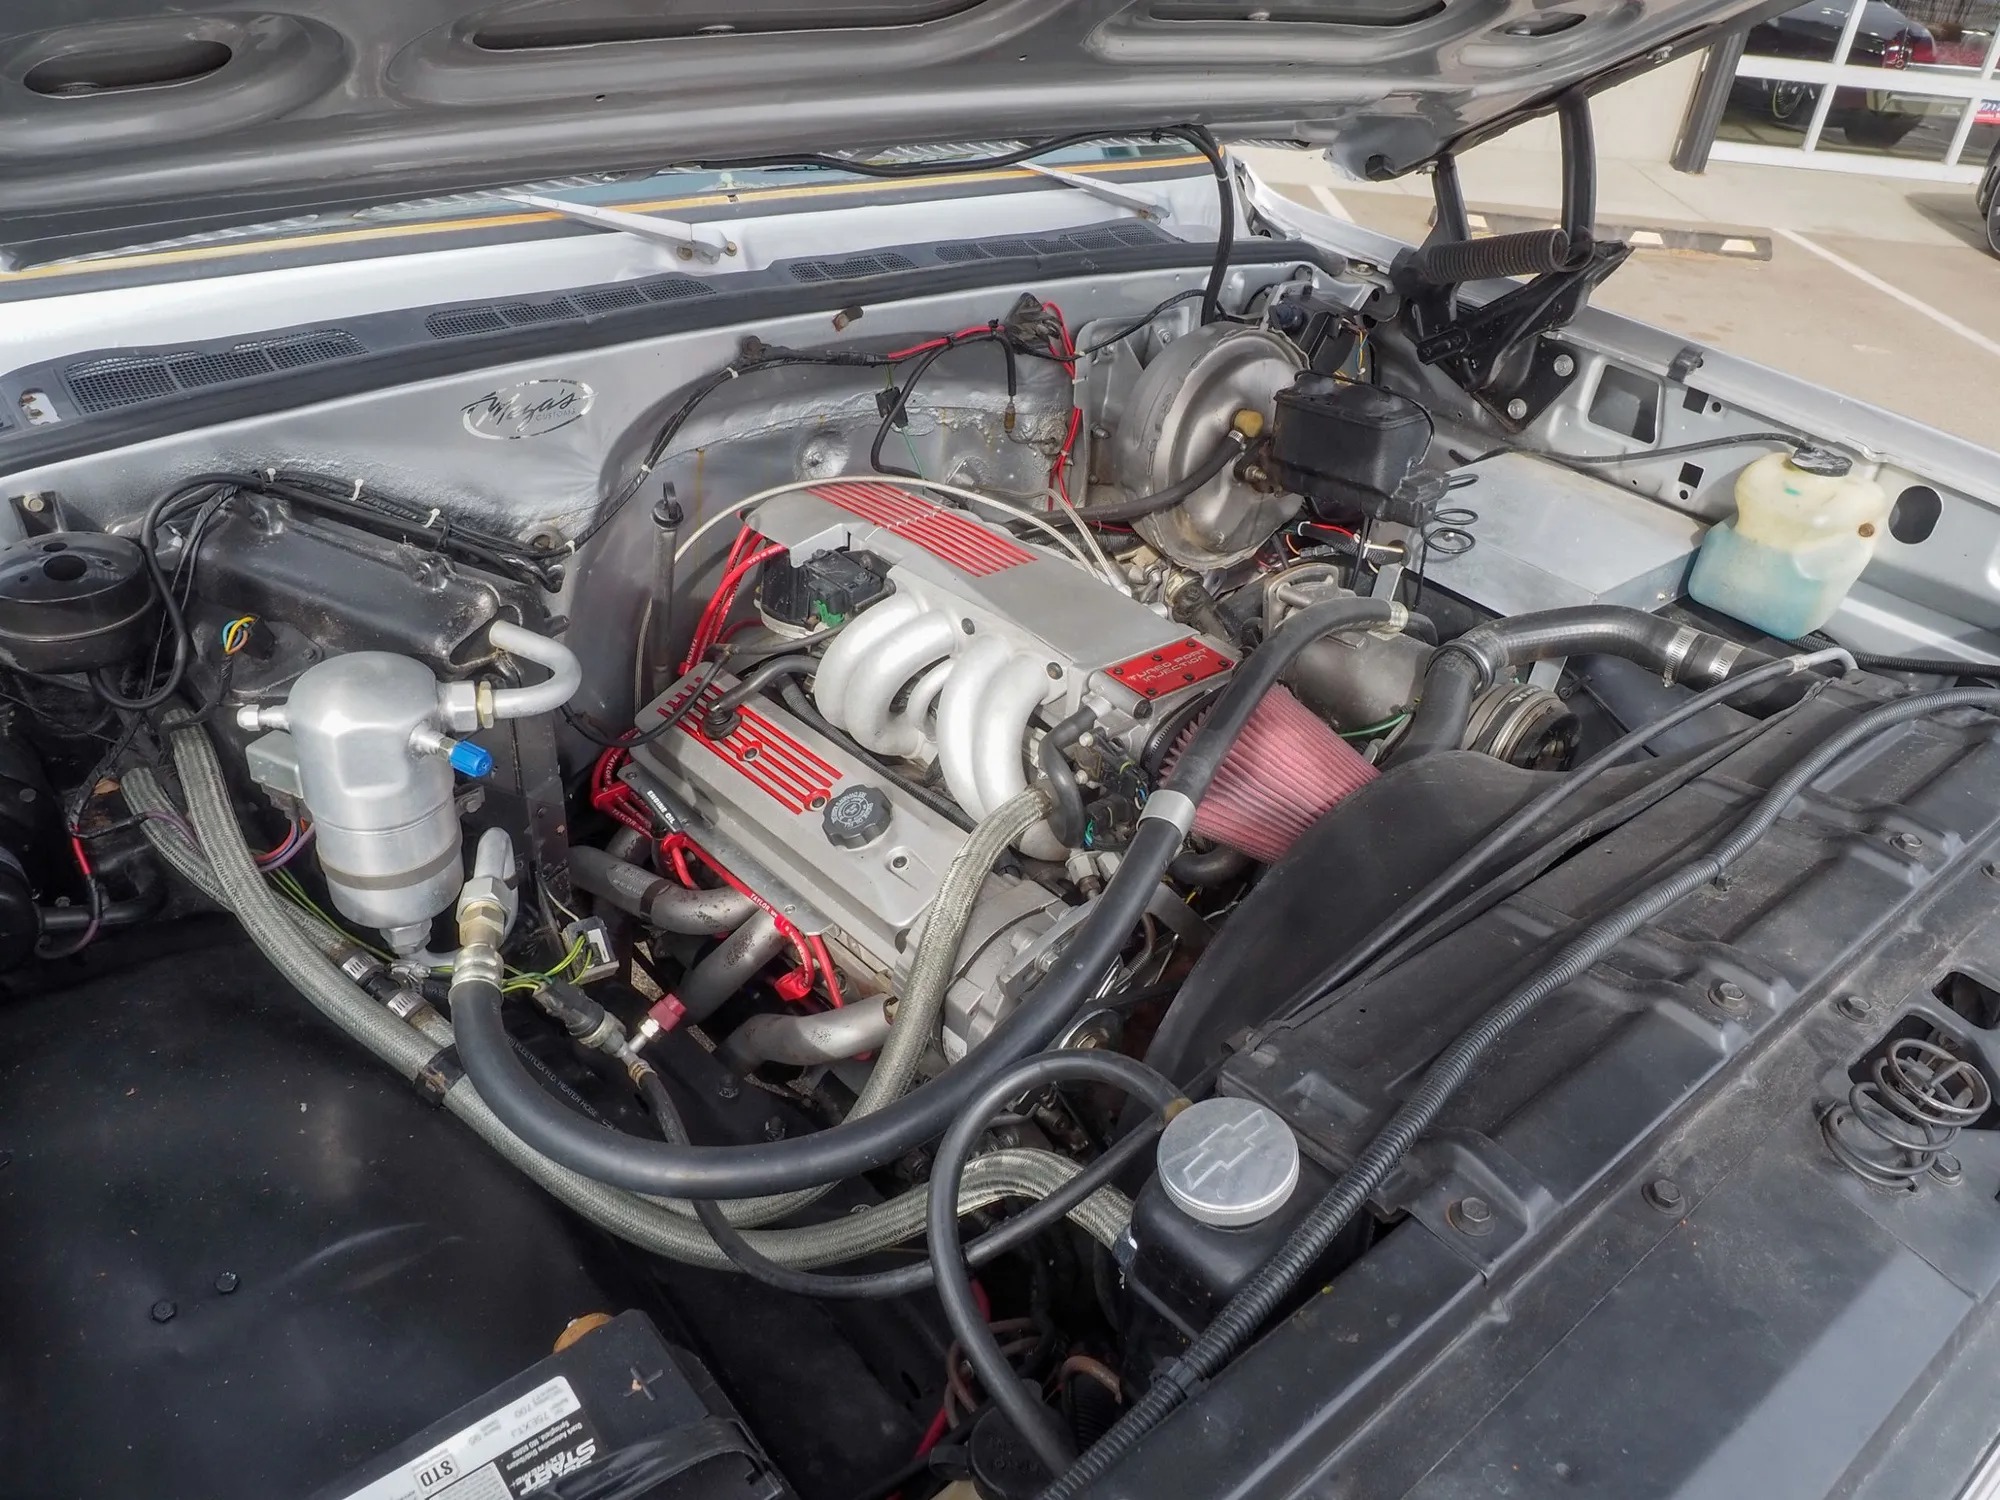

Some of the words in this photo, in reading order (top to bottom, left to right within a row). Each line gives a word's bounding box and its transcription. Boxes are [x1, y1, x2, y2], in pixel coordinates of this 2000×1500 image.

[1127, 661, 1172, 681] TUNED
[1173, 647, 1208, 664] PORT
[1143, 654, 1209, 682] INJECTION
[646, 789, 668, 814] ENGINE
[664, 812, 676, 825] OIL
[750, 893, 771, 911] TAYLOR
[557, 1080, 581, 1103] HEATER
[580, 1100, 598, 1118] HOSE
[420, 1460, 453, 1487] STD
[520, 1438, 596, 1496] START
